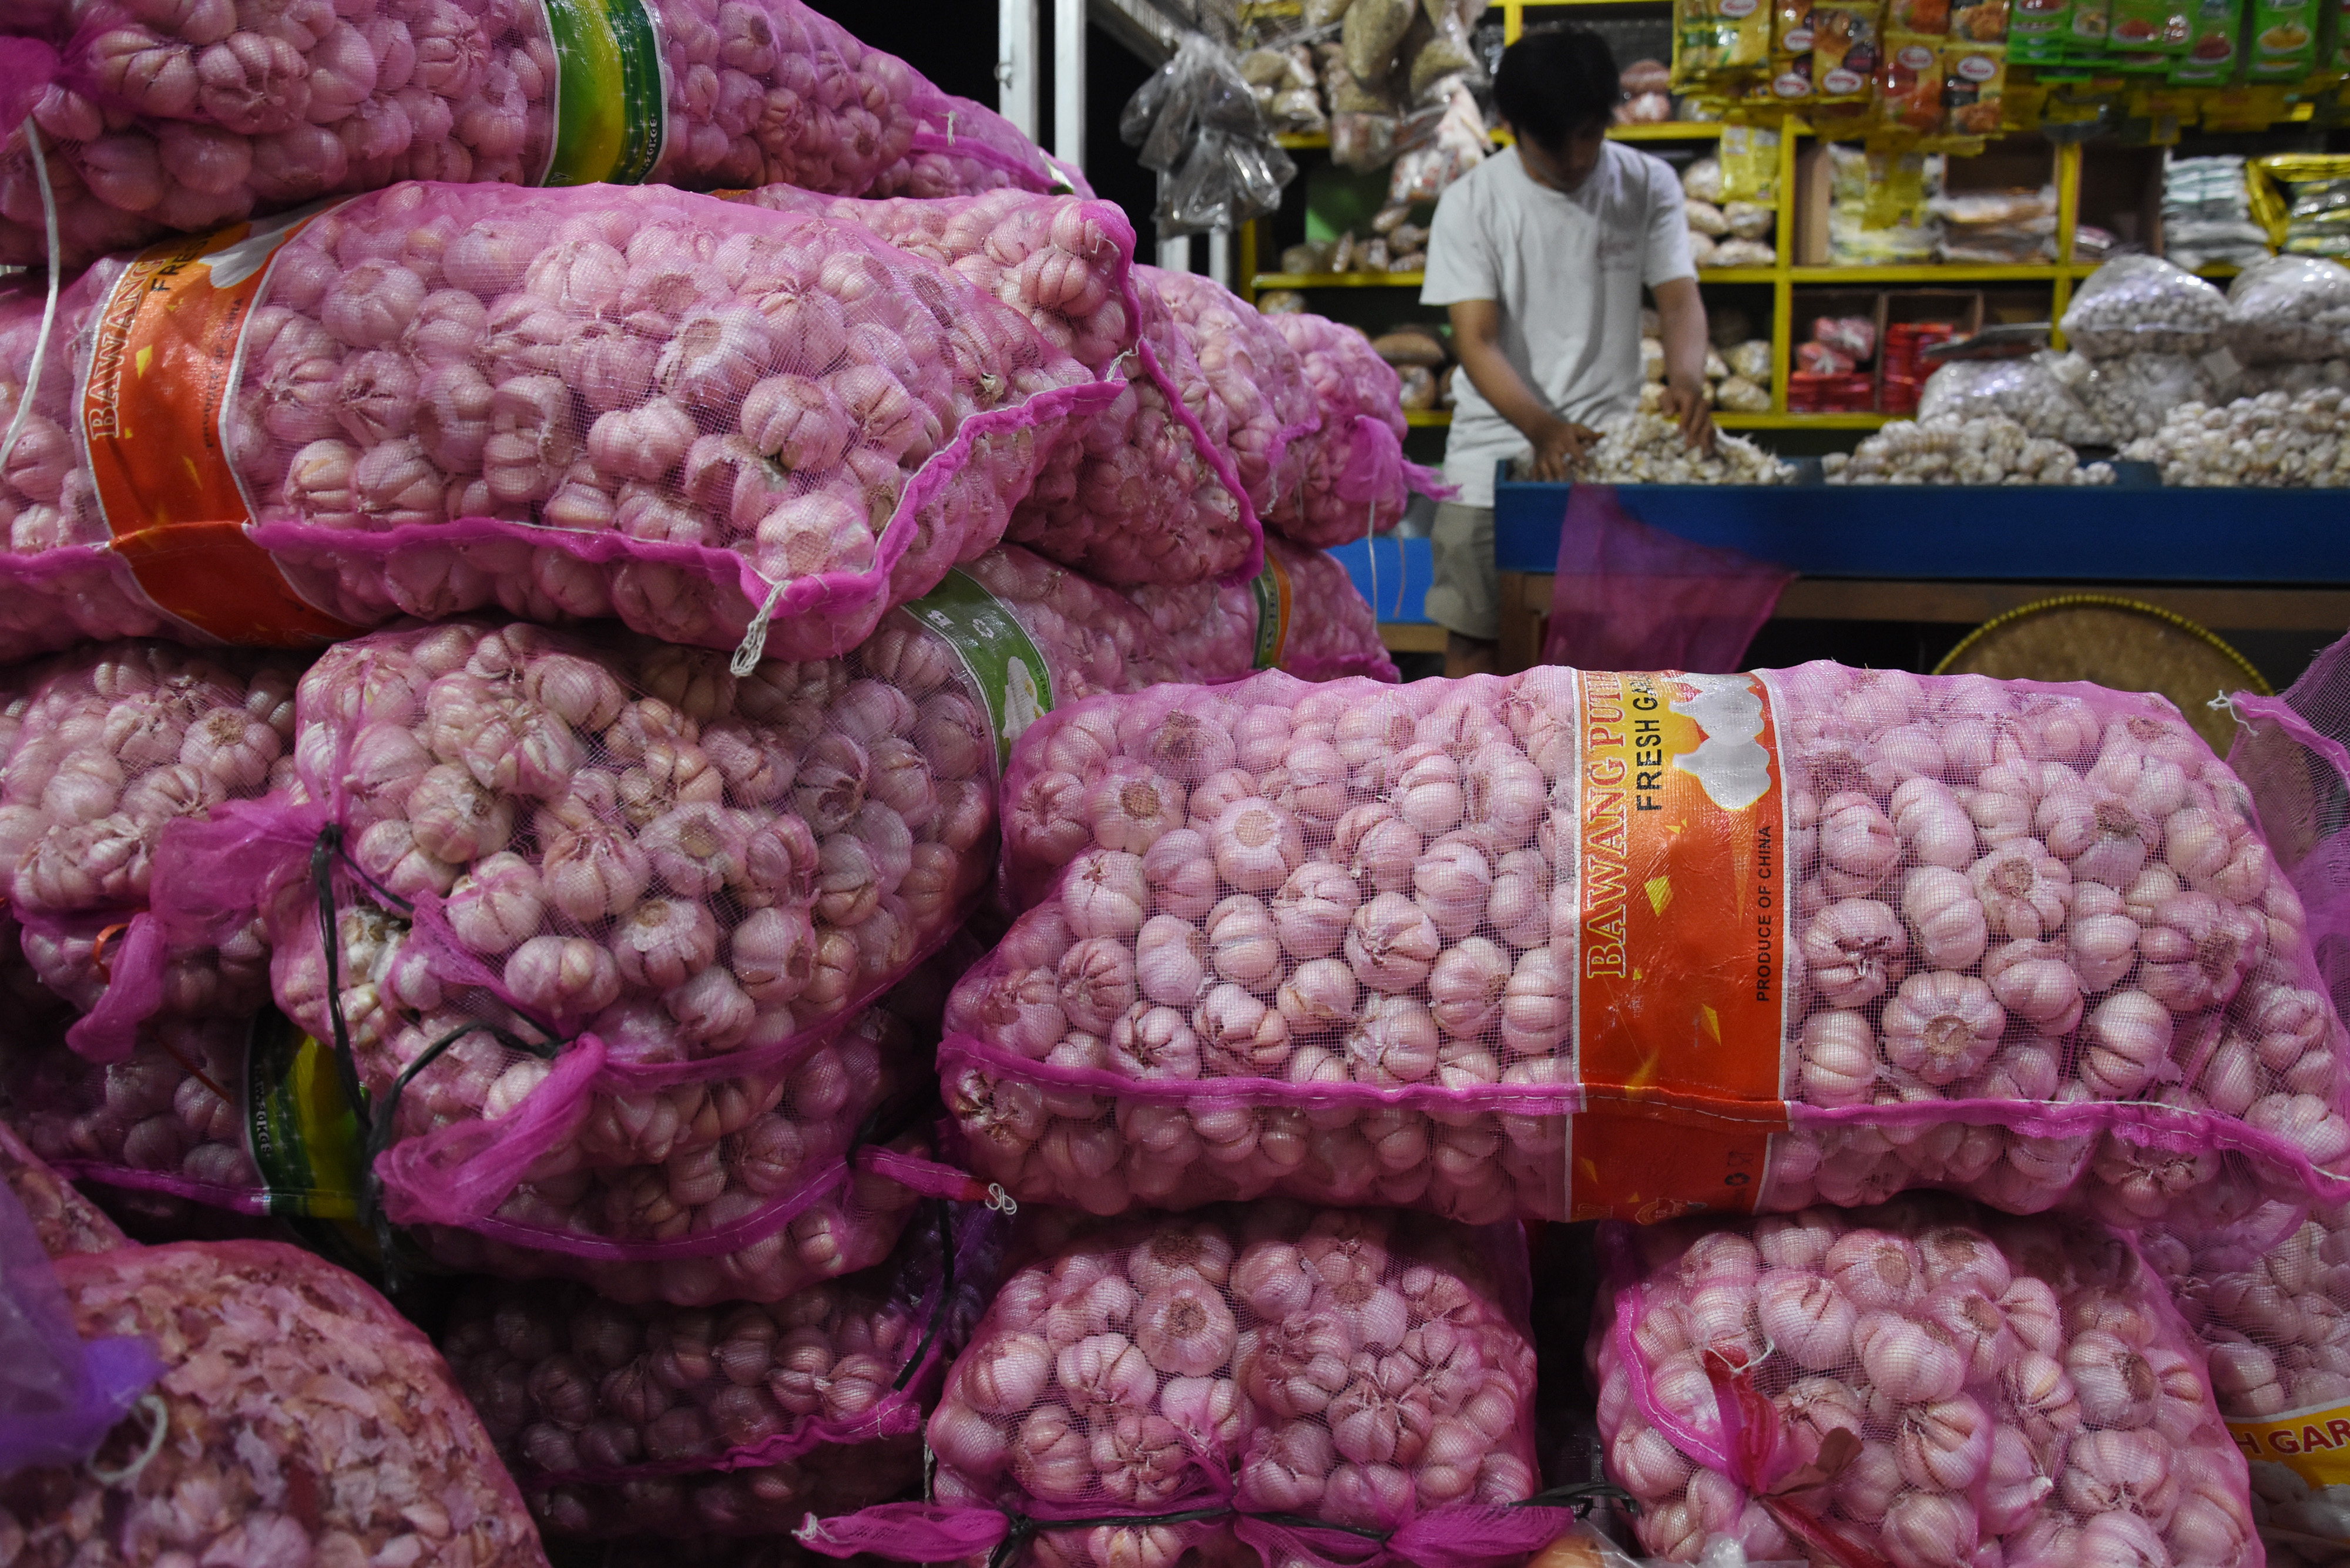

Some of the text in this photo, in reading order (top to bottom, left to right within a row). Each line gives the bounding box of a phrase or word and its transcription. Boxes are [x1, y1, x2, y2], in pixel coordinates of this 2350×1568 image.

[89, 258, 166, 440] BAWANG
[1634, 720, 1662, 811] FRESH
[1586, 756, 1627, 979] BAWANG
[1756, 825, 1771, 1002] PRODUCE OF CHINA
